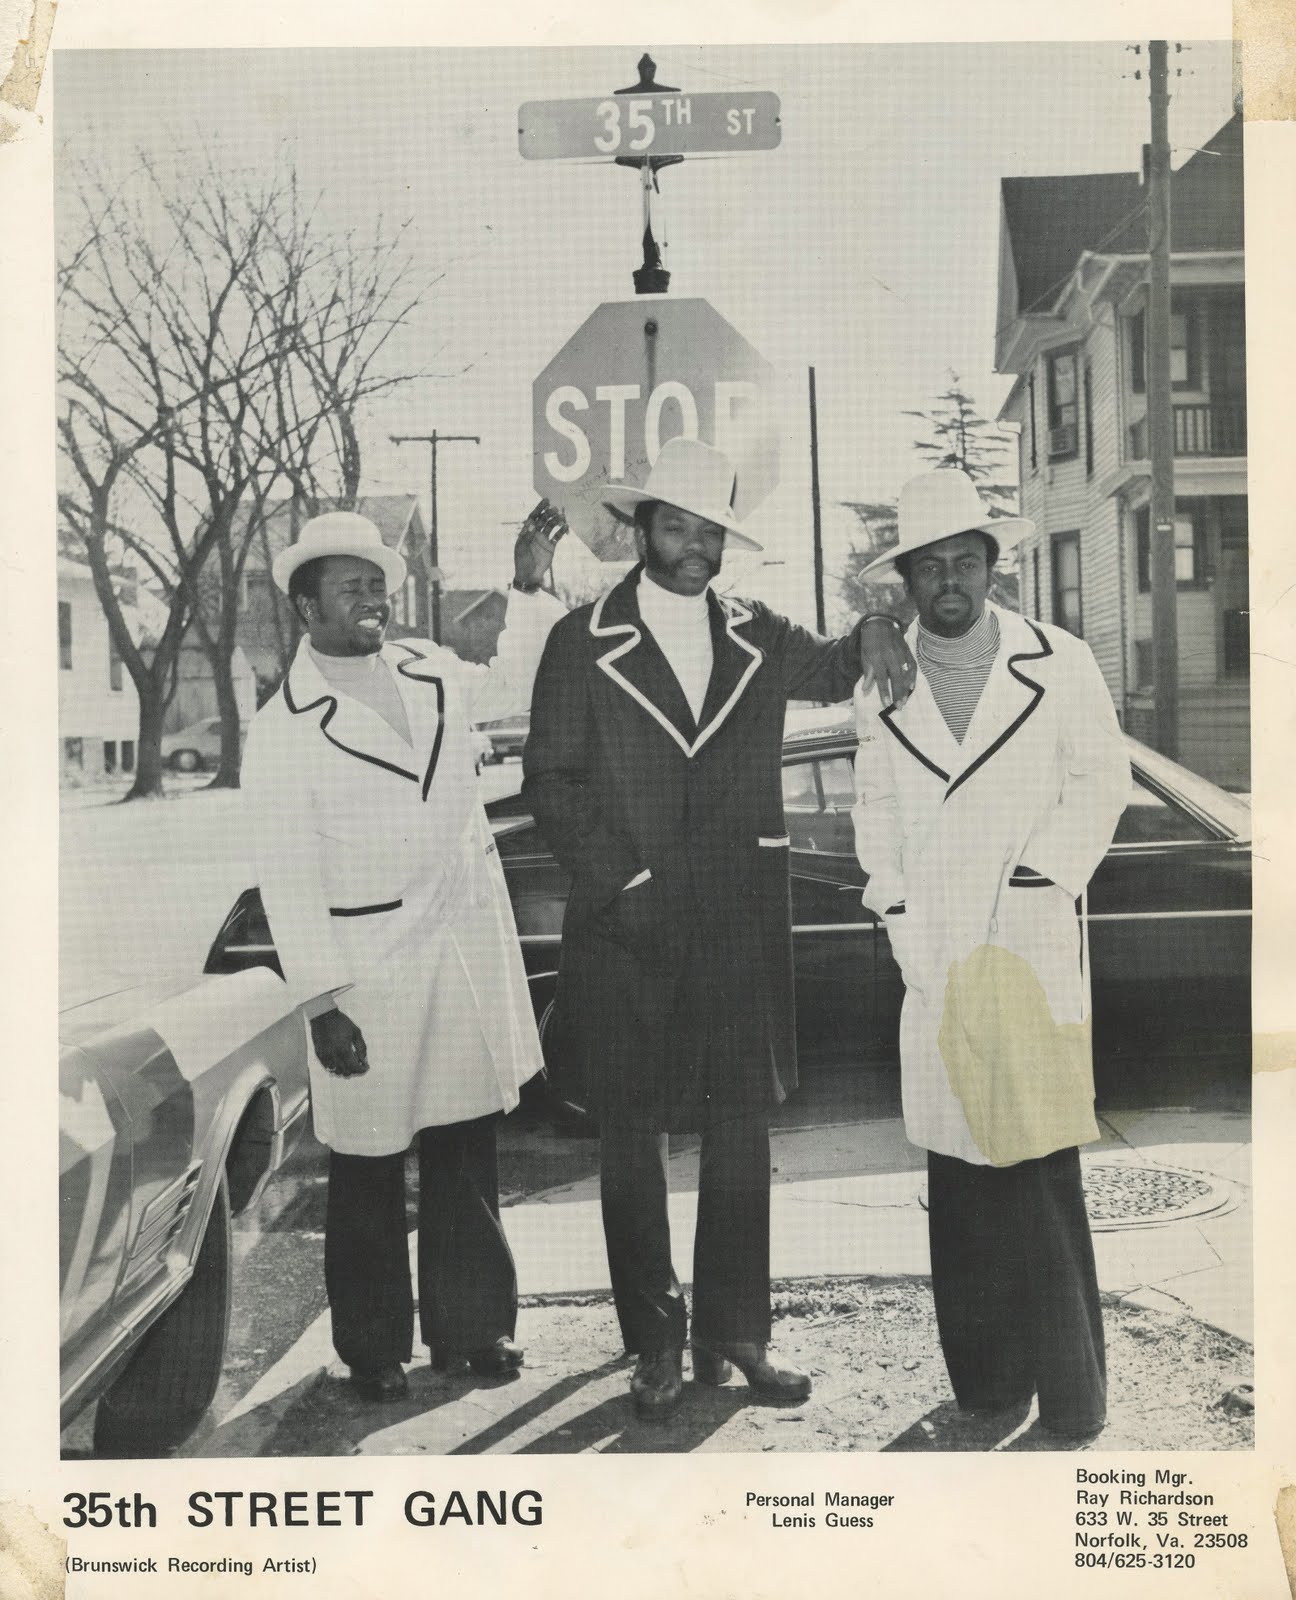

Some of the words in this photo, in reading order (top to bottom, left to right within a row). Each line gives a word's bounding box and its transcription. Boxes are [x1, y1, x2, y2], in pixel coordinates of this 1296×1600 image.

[726, 108, 756, 135] ST
[1076, 1468, 1146, 1488] Booking
[1155, 1469, 1193, 1488] Mgr.
[746, 1492, 814, 1507] Personal
[825, 1492, 895, 1510] Manager
[1076, 1490, 1109, 1508] Ray
[1120, 1490, 1214, 1506] Richardson
[62, 1492, 157, 1528] 35th
[187, 1490, 374, 1528] STREET
[404, 1489, 544, 1527] GANG
[772, 1513, 816, 1528] Lenis
[825, 1512, 874, 1528] Guess
[1075, 1511, 1108, 1526] 633
[1116, 1511, 1138, 1527] W.
[1148, 1511, 1168, 1527] 35
[1177, 1511, 1229, 1527] Street
[1075, 1532, 1148, 1551] Norfolk,
[1156, 1533, 1185, 1549] Va.
[1194, 1533, 1249, 1548] 23508
[65, 1556, 157, 1574] (Brunswick
[168, 1557, 253, 1576] Recording
[262, 1557, 318, 1574] Artist)
[1074, 1551, 1196, 1569] 804/625-3120
